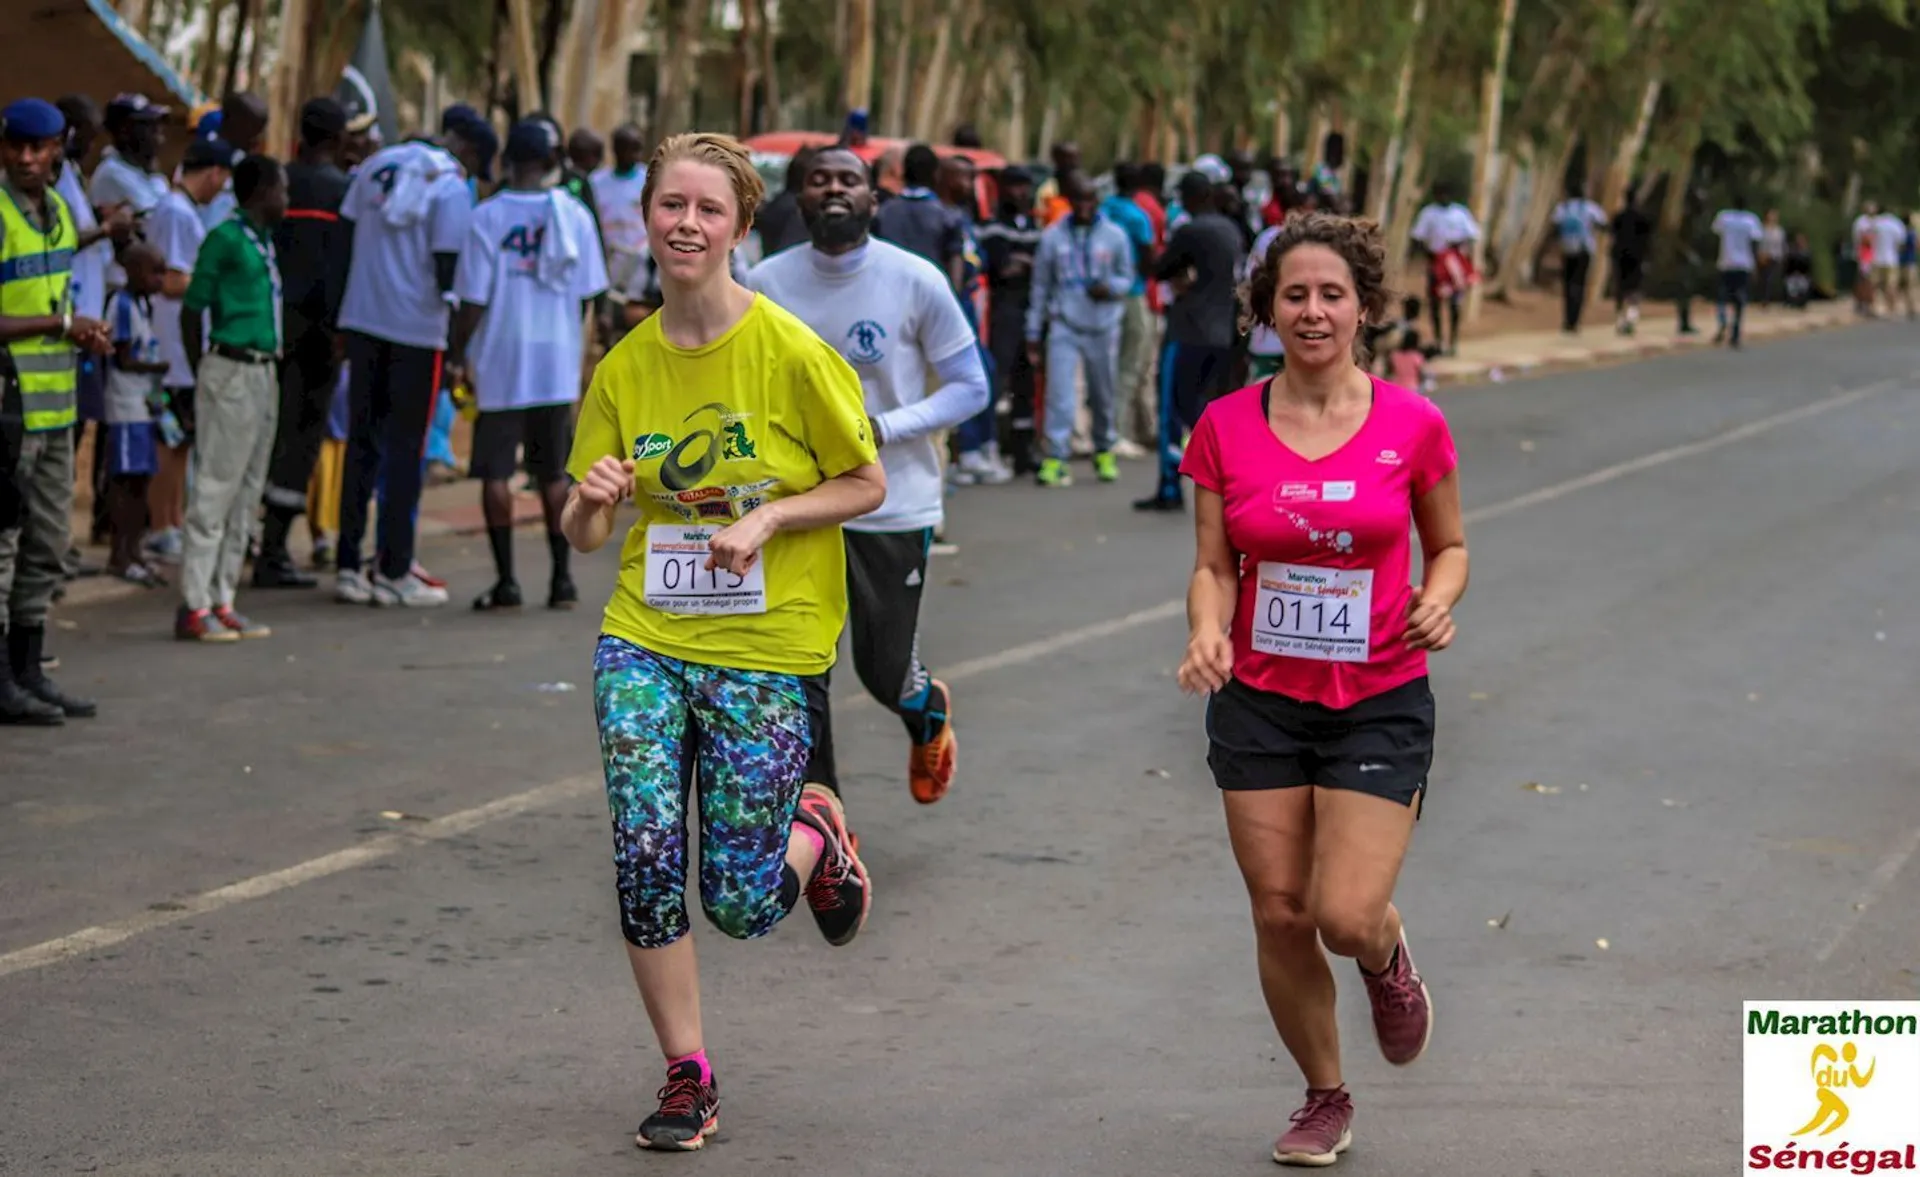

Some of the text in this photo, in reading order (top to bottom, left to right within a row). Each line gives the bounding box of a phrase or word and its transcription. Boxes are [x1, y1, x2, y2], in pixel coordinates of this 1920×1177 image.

[1288, 572, 1327, 584] Marathon
[702, 598, 731, 607] Sénégal
[733, 598, 759, 607] propre
[1268, 597, 1351, 633] 0114
[1305, 641, 1334, 653] Sénégal
[1337, 646, 1361, 654] propre
